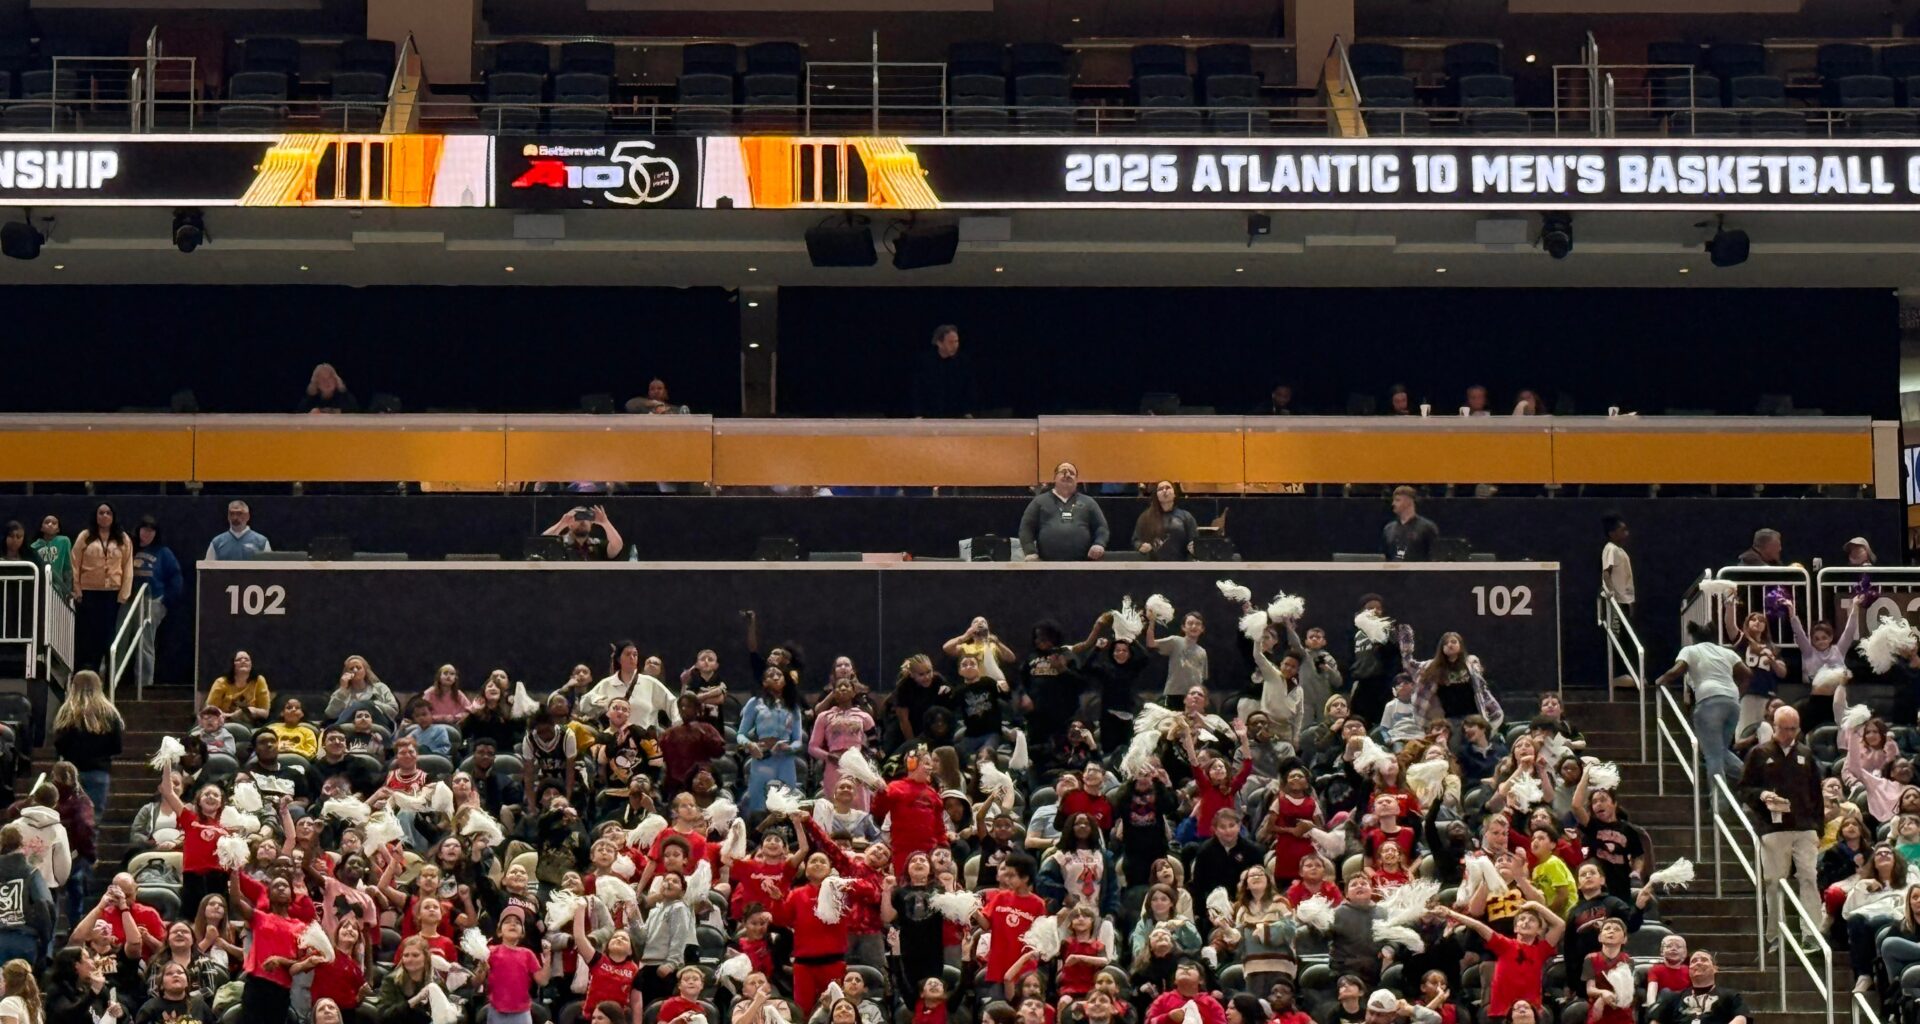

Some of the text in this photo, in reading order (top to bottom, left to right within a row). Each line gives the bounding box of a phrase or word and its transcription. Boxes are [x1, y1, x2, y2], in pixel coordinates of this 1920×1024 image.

[1065, 153, 1178, 192] 2026
[1192, 154, 1399, 193] ATLANTIC
[1412, 154, 1458, 193] 10
[1472, 155, 1605, 193] MEN'S
[1618, 155, 1894, 194] BASKETBALL
[225, 584, 286, 615] 102
[1471, 585, 1533, 616] 102
